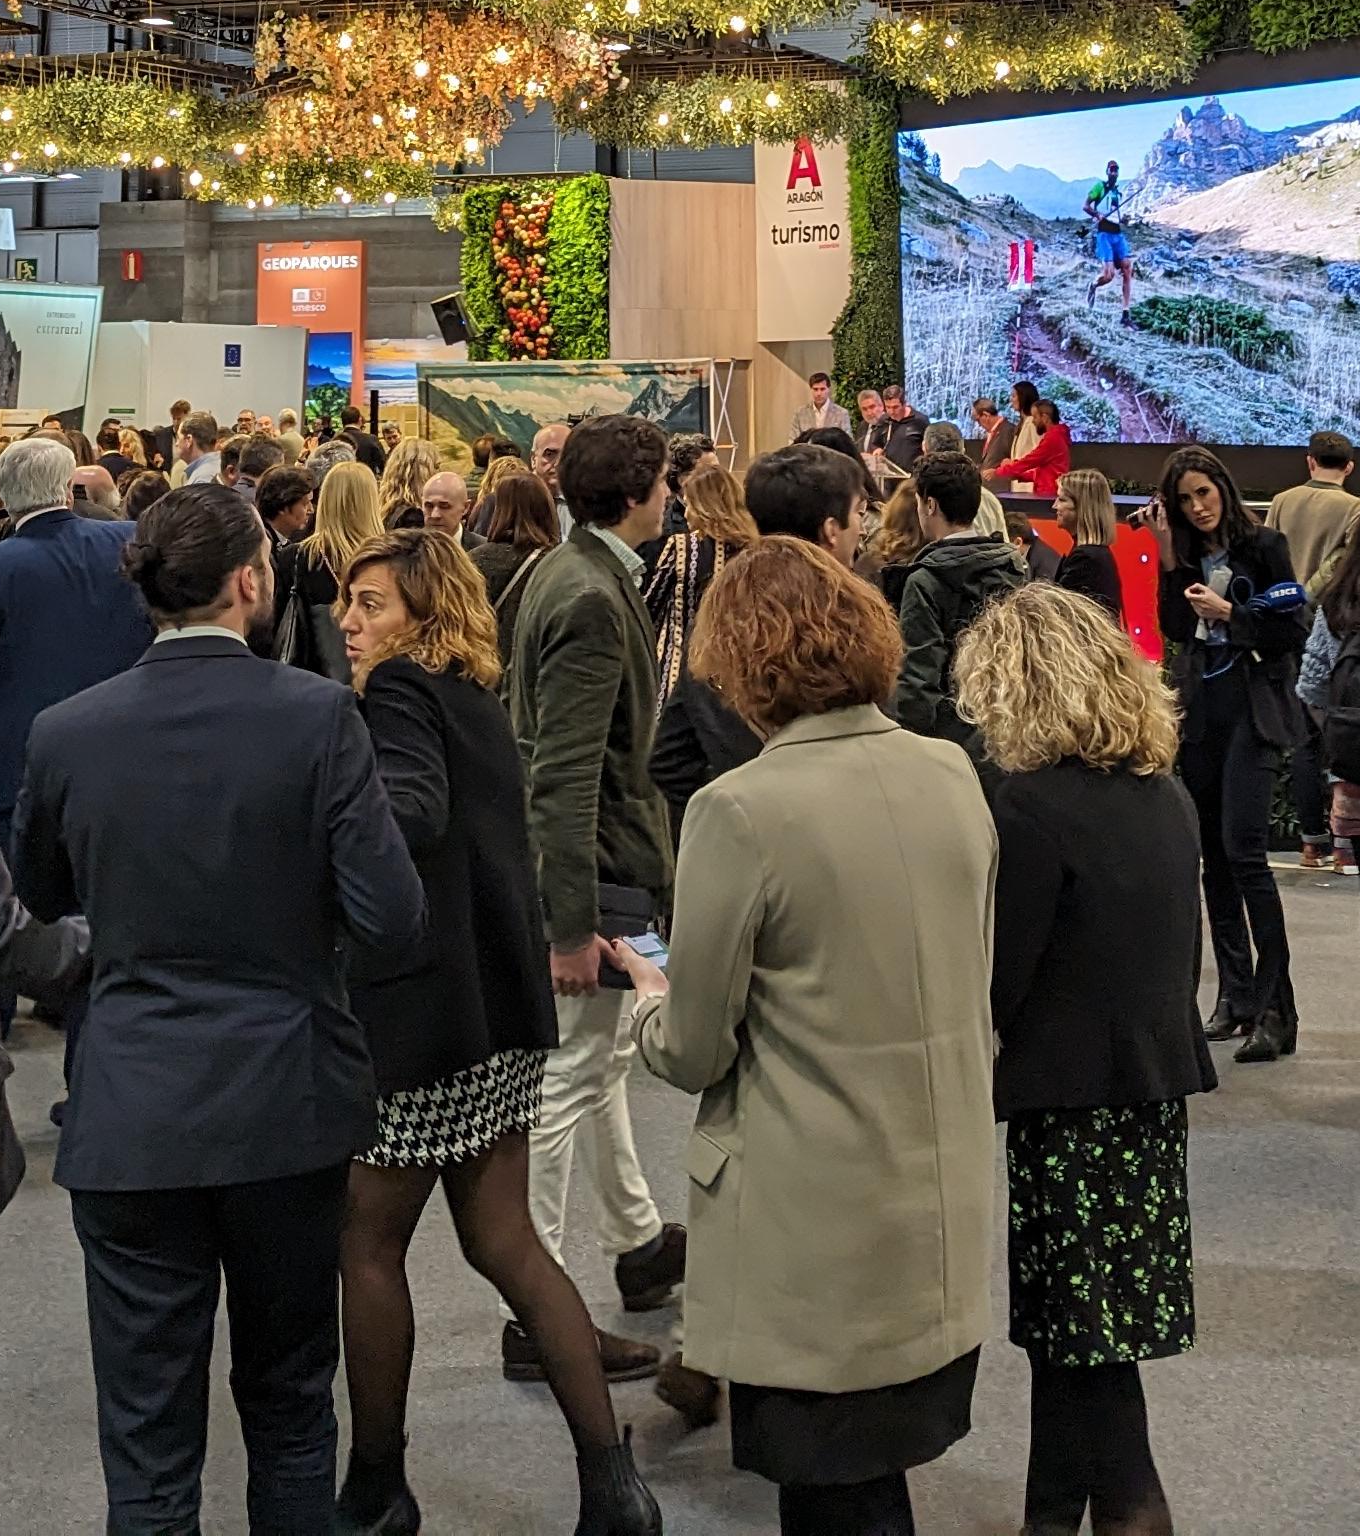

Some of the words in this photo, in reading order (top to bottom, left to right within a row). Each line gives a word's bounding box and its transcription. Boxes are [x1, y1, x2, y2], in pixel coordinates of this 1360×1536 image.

[787, 187, 823, 204] ARAGÓN
[771, 220, 840, 245] turismo
[262, 256, 358, 271] GEOPARQUES
